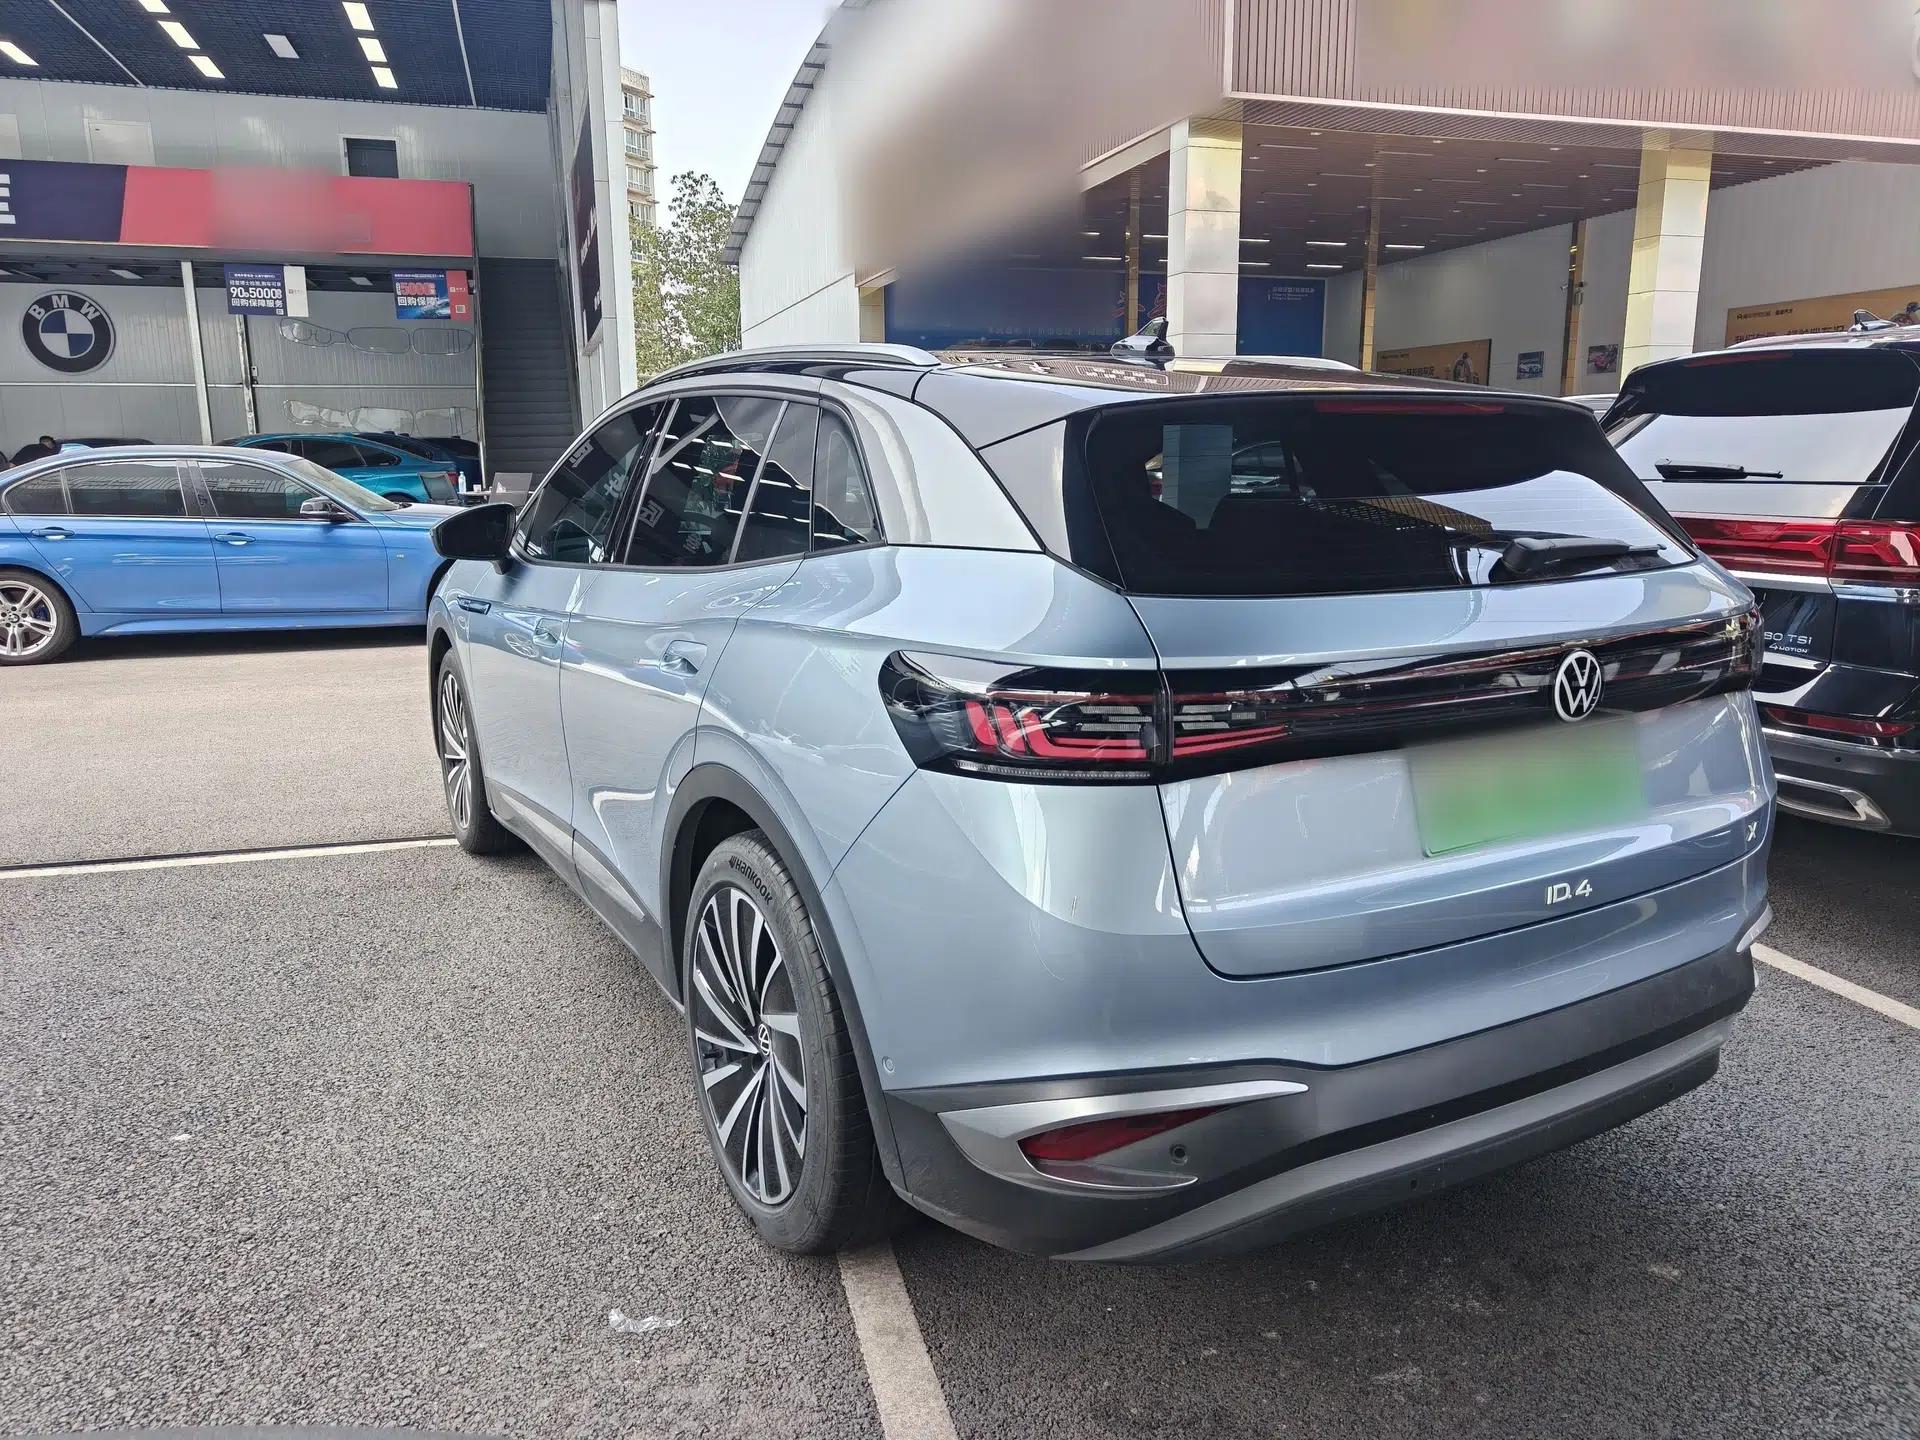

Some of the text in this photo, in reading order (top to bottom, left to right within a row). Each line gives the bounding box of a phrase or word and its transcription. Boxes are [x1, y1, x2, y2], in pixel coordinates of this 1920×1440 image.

[28, 294, 100, 320] BMW
[231, 297, 283, 308] 回购保障服务
[1746, 821, 1758, 842] X
[1546, 879, 1593, 905] ID.4
